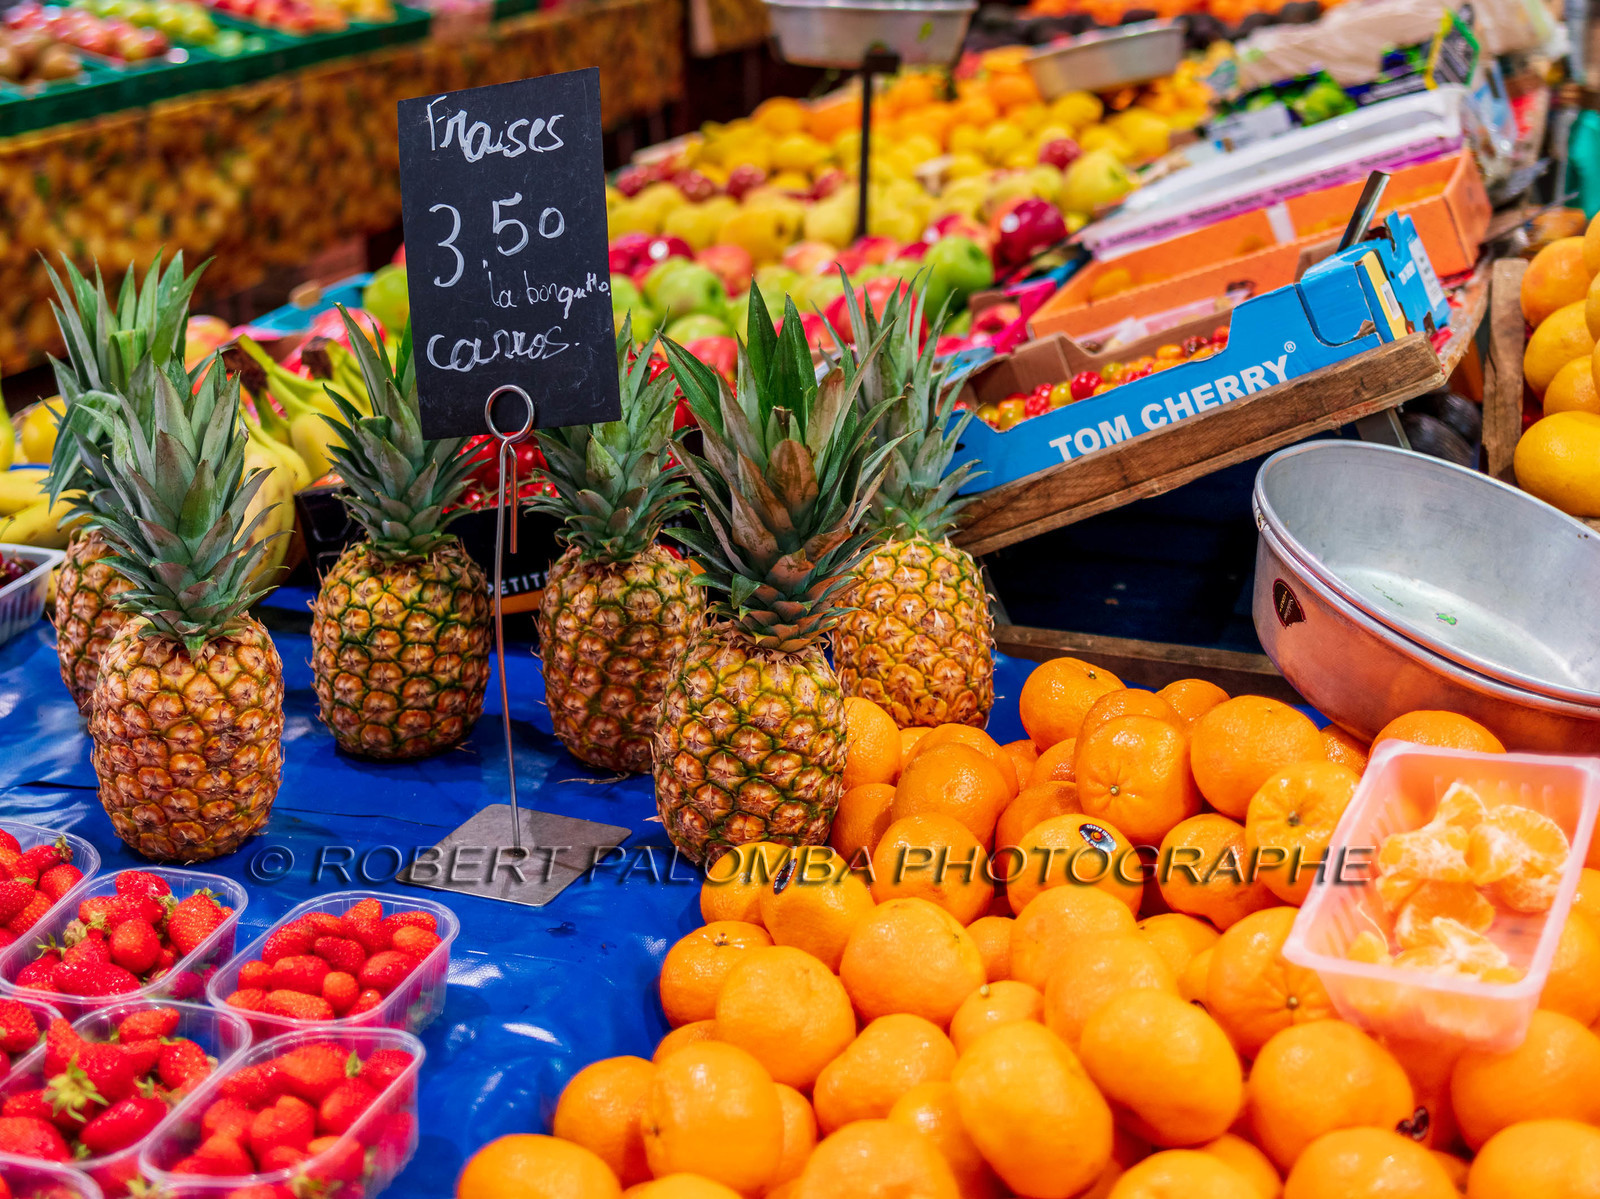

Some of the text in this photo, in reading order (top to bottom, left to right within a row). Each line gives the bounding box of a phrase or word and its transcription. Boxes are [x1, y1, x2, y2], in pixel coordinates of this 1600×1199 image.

[426, 95, 565, 163] Fraises
[488, 270, 517, 308] la
[1048, 414, 1134, 462] TOM
